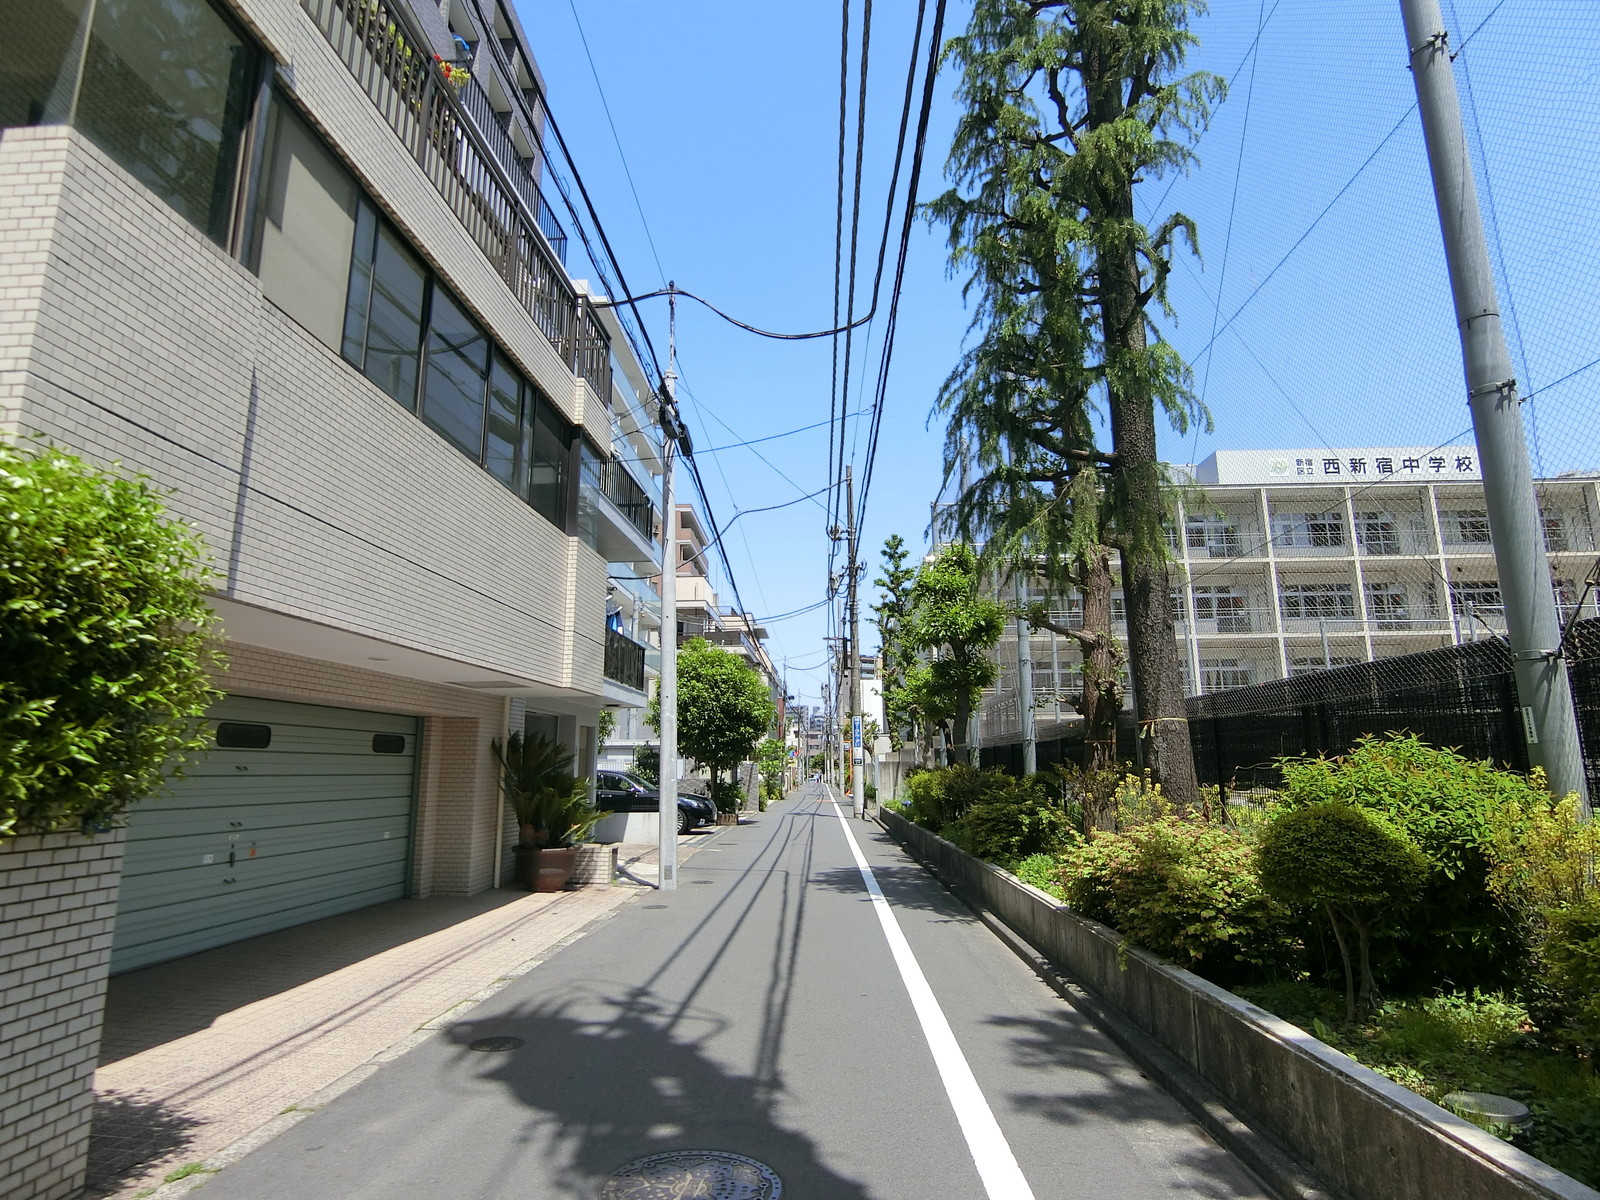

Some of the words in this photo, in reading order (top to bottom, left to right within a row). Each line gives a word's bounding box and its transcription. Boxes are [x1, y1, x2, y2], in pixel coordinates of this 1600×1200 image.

[1295, 458, 1313, 467] 新宿
[1322, 455, 1473, 475] 西新宿中学校
